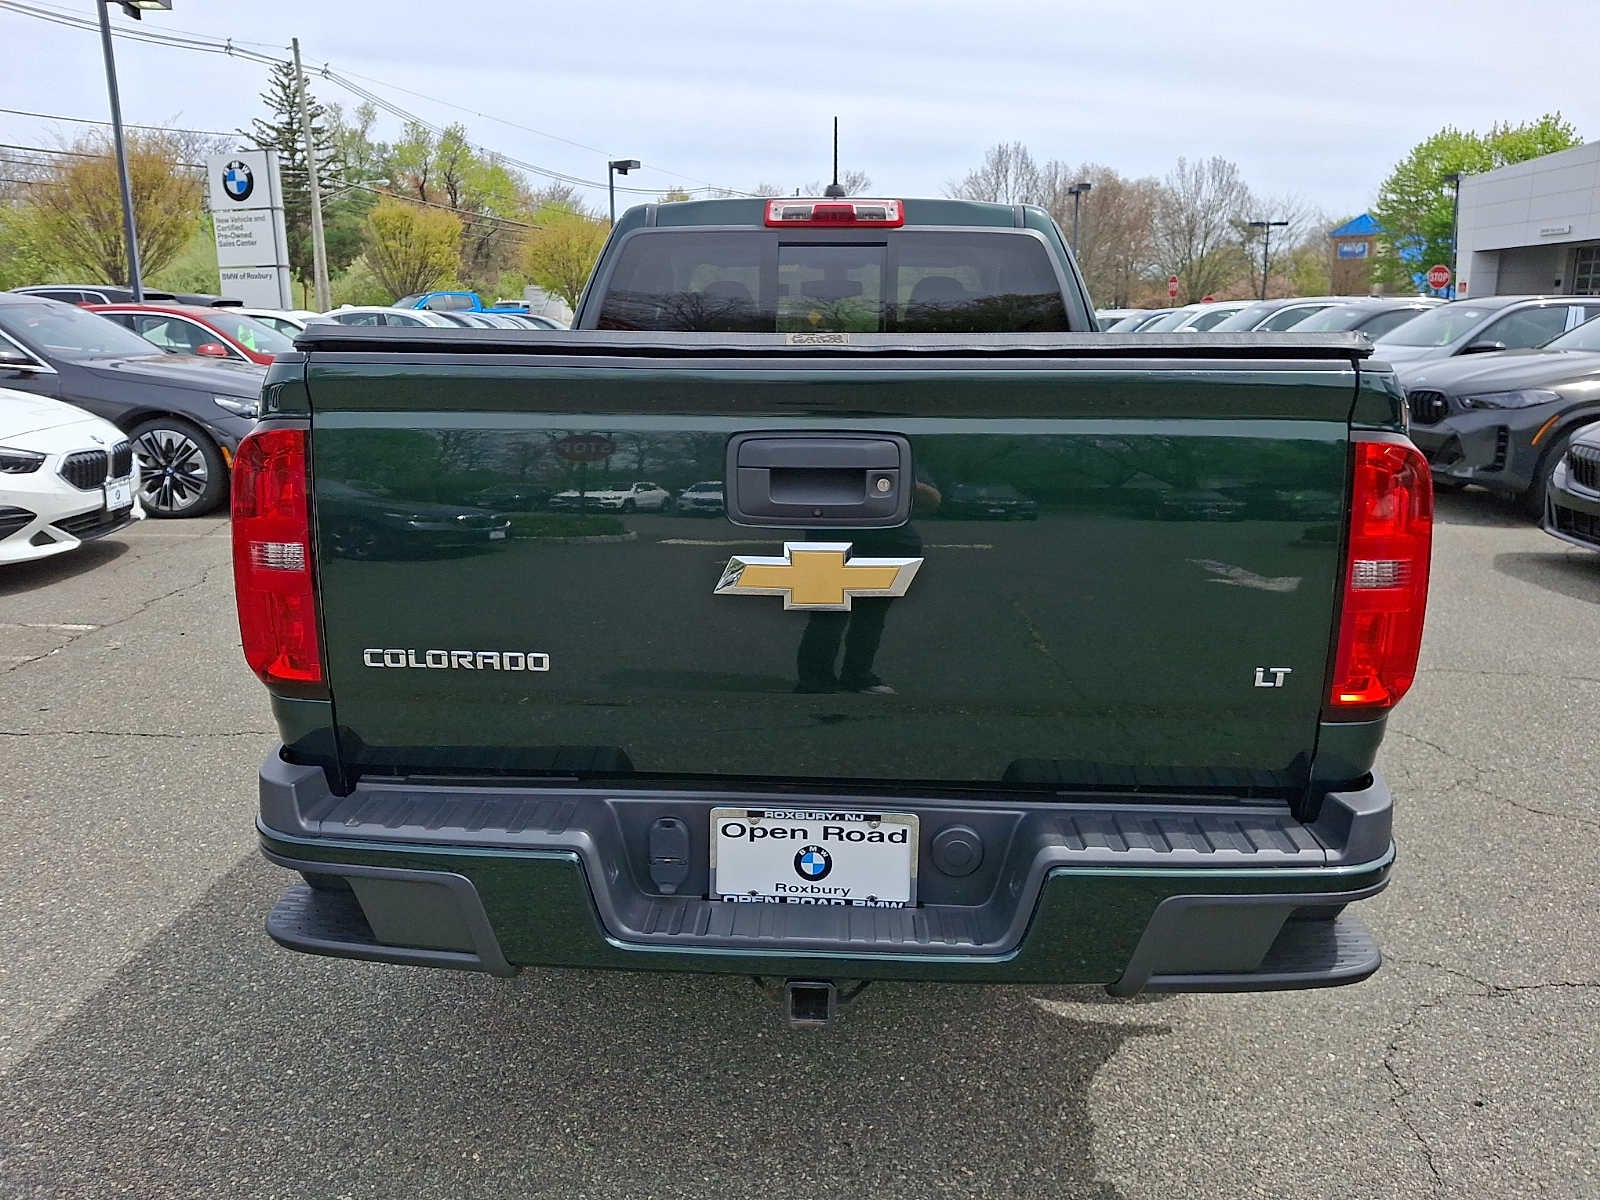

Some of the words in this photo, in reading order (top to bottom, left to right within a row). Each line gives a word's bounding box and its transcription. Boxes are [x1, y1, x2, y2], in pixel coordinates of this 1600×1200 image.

[230, 215, 252, 223] Vehicle
[216, 224, 244, 232] Certified
[217, 232, 252, 240] Pre-Owned
[218, 240, 235, 248] Sales
[235, 239, 257, 247] Center
[221, 272, 239, 281] BMW
[239, 271, 246, 280] of
[246, 271, 273, 281] Roxbury
[1429, 271, 1449, 282] STOP
[363, 648, 550, 672] COLORADO
[1254, 667, 1293, 687] LT
[844, 813, 865, 822] NJ
[721, 822, 808, 842] Open
[822, 825, 908, 844] Road
[775, 883, 851, 897] Roxbury
